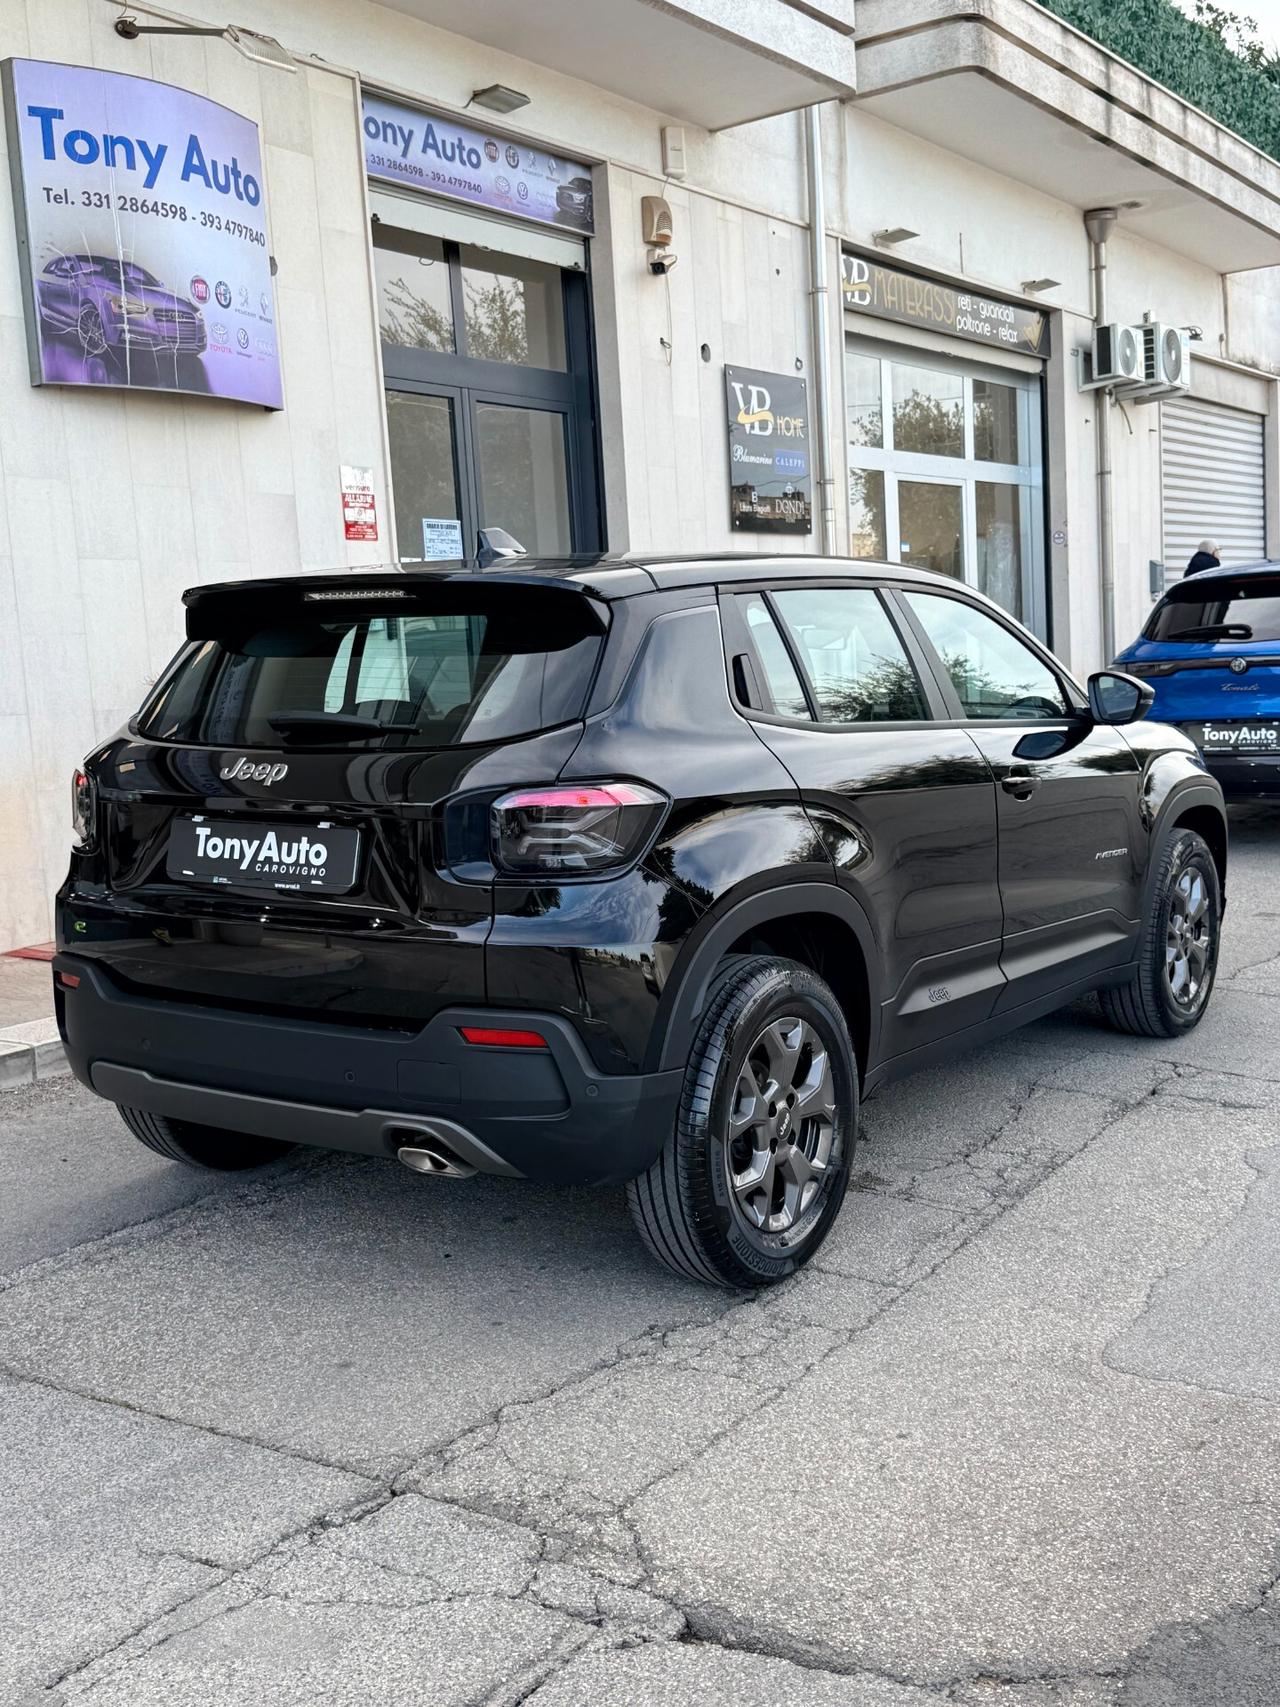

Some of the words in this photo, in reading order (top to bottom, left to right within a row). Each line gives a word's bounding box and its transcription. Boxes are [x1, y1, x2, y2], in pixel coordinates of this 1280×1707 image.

[361, 103, 414, 159] ony
[421, 123, 482, 170] Auto
[27, 105, 168, 190] Tony
[181, 134, 261, 207] Auto
[371, 154, 386, 167] 331
[387, 158, 424, 178] 2864598
[431, 171, 446, 184] 393
[448, 175, 483, 194] 4797840
[42, 187, 76, 206] Tel.
[81, 190, 112, 210] 331
[117, 195, 188, 223] 2864598
[200, 212, 223, 232] 393
[224, 219, 266, 248] 4797840
[873, 269, 956, 327] MATERASSI
[957, 294, 971, 311] reti
[979, 300, 1016, 325] guanciali
[956, 313, 991, 337] poltrone
[998, 326, 1018, 343] relax
[731, 382, 774, 437] VB
[776, 416, 805, 439] HOME
[1202, 727, 1277, 744] TonyAuto
[219, 757, 288, 786] Jeep
[195, 827, 328, 870] TonyAuto
[255, 863, 327, 877] CAROVIGNO
[928, 986, 951, 1002] Jeep
[780, 1113, 791, 1135] Jeep
